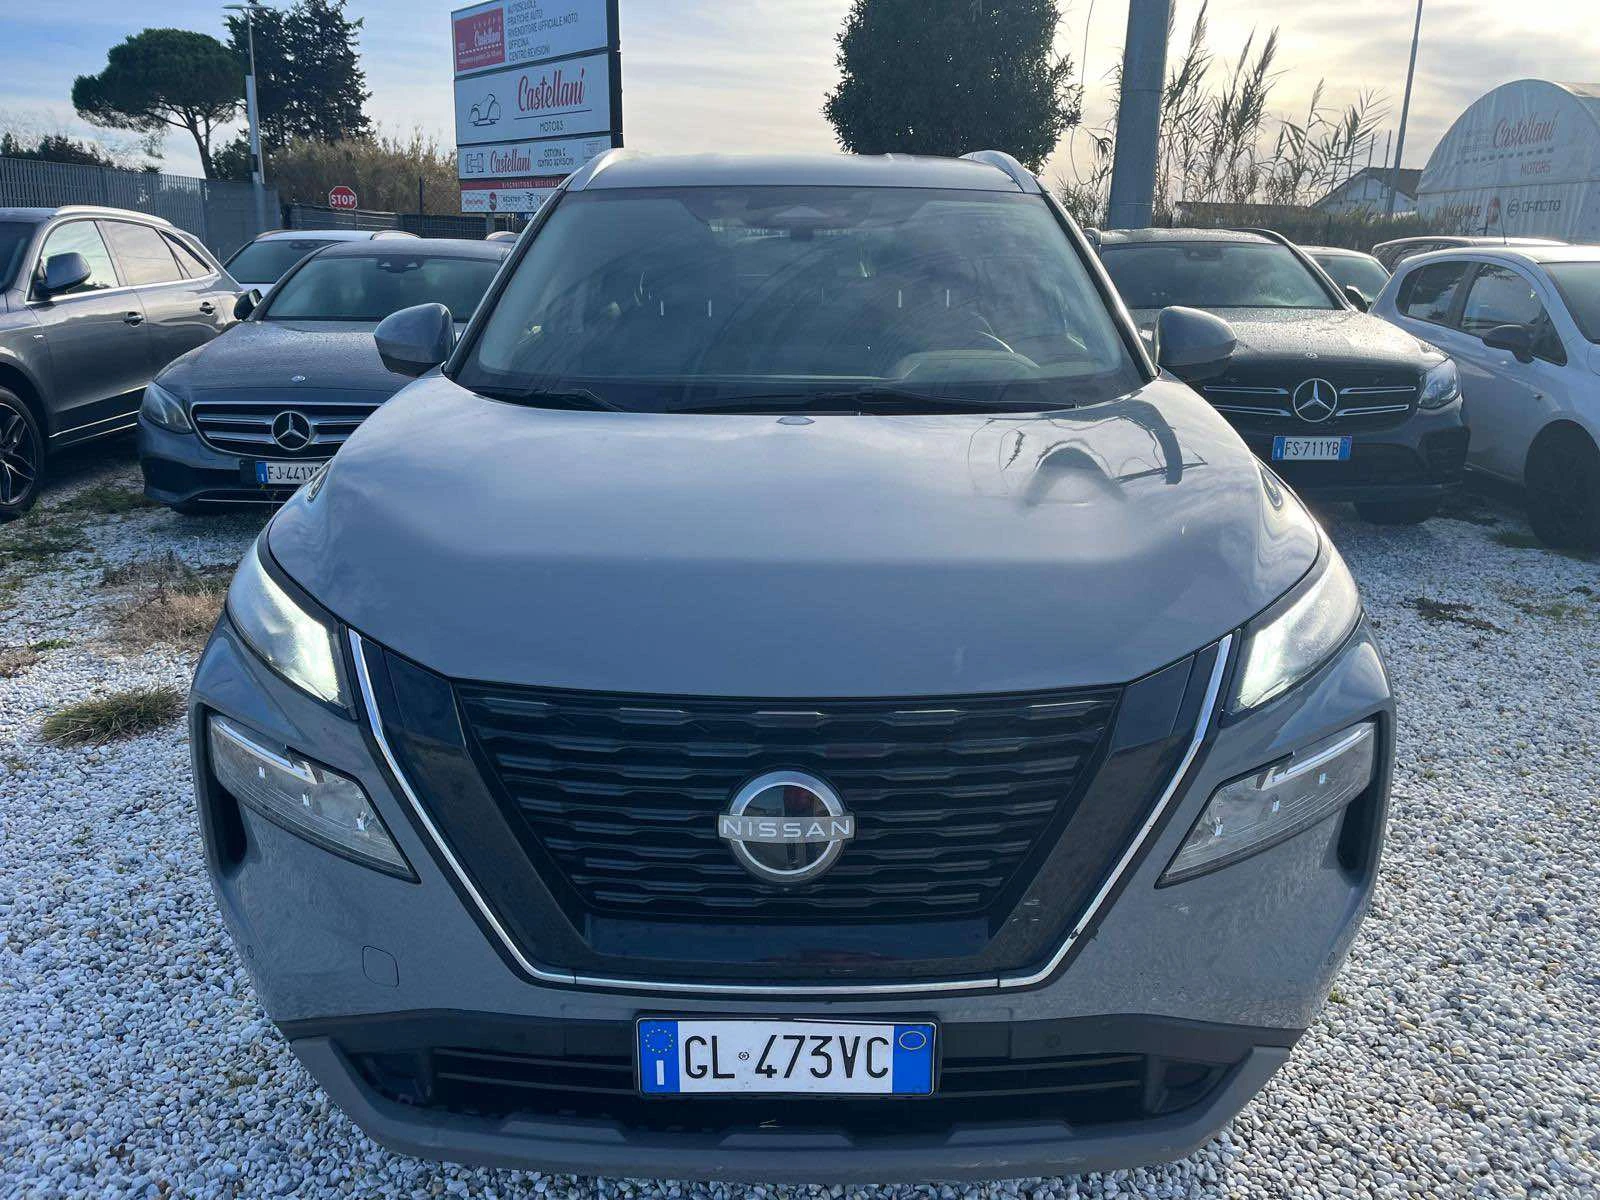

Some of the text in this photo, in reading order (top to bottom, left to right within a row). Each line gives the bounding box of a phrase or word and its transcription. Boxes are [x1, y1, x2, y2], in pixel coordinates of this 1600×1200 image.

[518, 68, 585, 111] Castellani
[540, 120, 564, 132] MOTORS
[490, 148, 531, 173] Castellani
[331, 194, 355, 205] STOP
[722, 818, 850, 838] NISSAN
